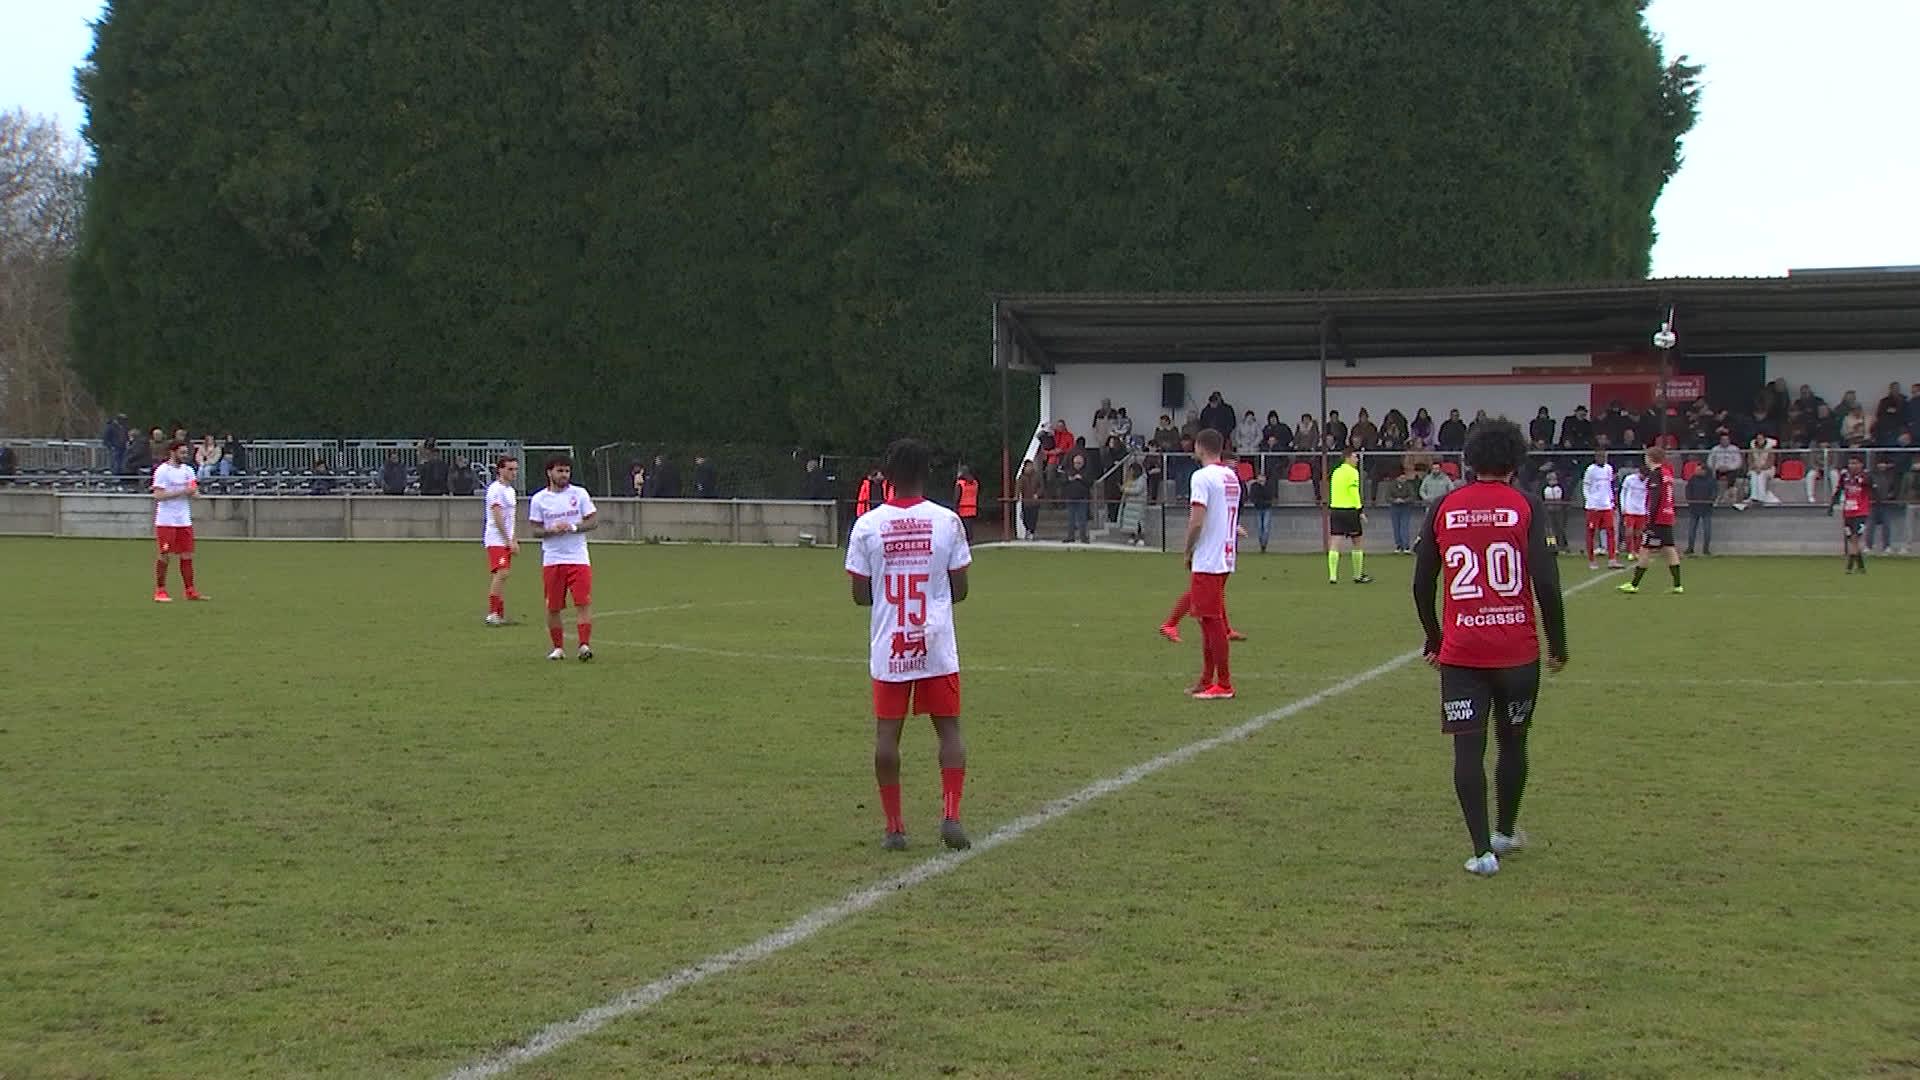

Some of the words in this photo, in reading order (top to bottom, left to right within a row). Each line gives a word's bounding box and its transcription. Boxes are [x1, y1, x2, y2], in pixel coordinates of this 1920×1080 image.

[1457, 512, 1505, 523] DESPRIET
[885, 541, 930, 553] GOBERT
[1445, 541, 1524, 601] 20
[884, 573, 930, 627] 45
[888, 659, 927, 674] DELHAIZE
